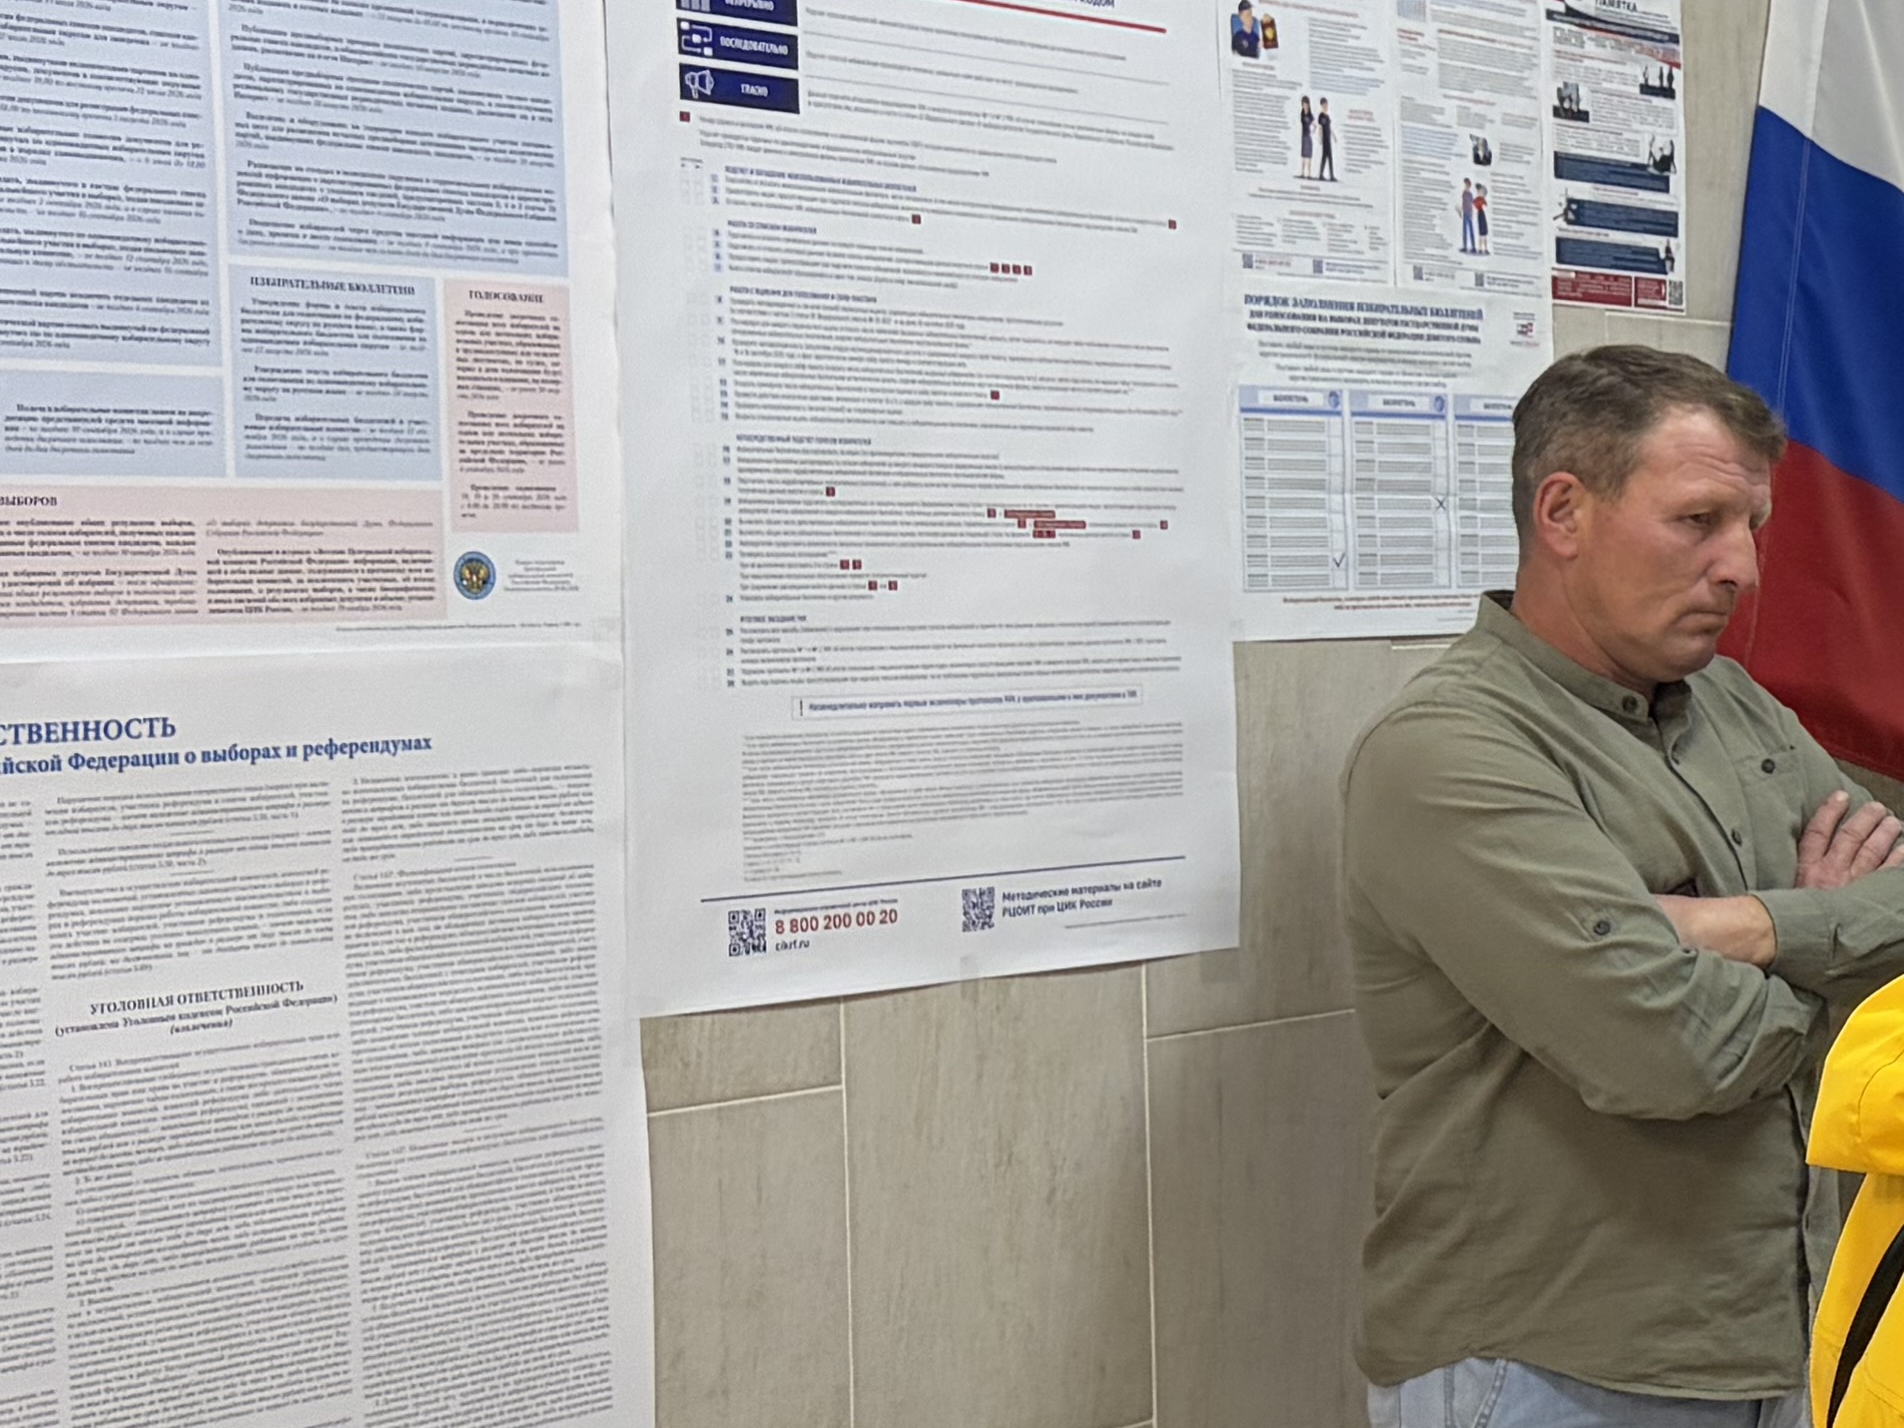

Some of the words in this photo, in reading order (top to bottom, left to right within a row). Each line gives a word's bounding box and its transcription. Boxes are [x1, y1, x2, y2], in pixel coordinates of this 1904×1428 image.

[67, 751, 180, 774] Федерации
[184, 751, 197, 765] о
[201, 743, 282, 766] выборах
[285, 744, 298, 758] и
[302, 737, 432, 762] референдумах
[1001, 887, 1070, 903] Методические
[1135, 879, 1163, 890] сайте
[1079, 898, 1113, 909] России
[774, 919, 786, 935] 8
[789, 915, 820, 934] 800
[823, 912, 852, 931] 200
[855, 910, 876, 927] 00
[878, 908, 898, 925] 20
[90, 994, 174, 1016] УГОЛОВНАЯ
[176, 980, 304, 1005] ОТВЕТСТВЕННОСТЬ
